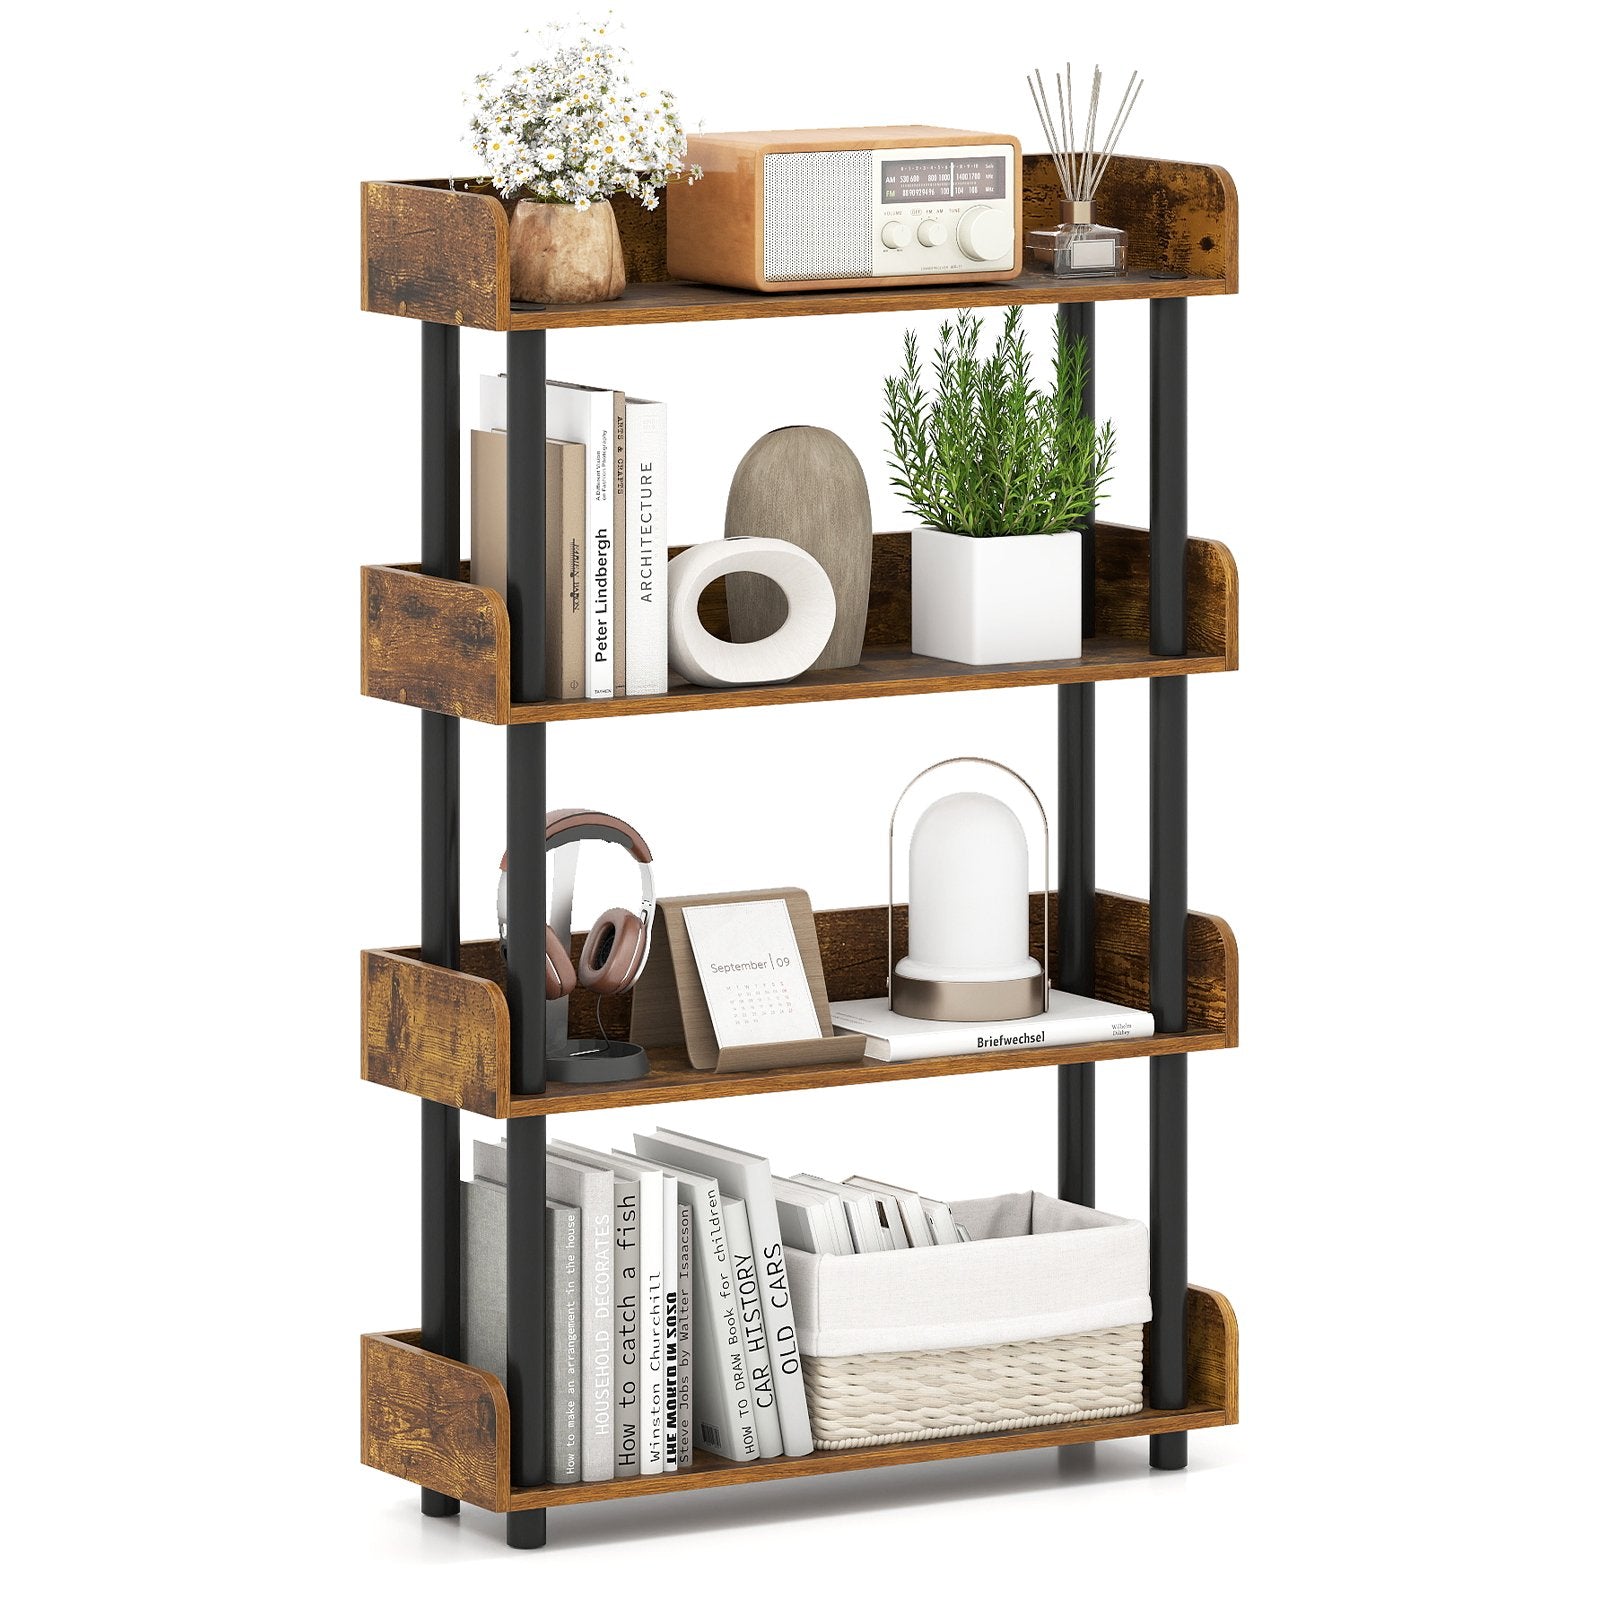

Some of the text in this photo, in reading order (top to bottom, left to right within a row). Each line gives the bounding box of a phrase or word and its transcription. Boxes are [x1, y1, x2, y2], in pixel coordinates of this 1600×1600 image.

[885, 176, 896, 184] AM
[594, 528, 611, 662] Peter Lindbergh
[640, 462, 653, 603] ARCHITECTURE
[710, 957, 790, 974] September 09
[977, 1031, 1045, 1048] Briefwechsel
[565, 1215, 577, 1474] How to make an arrangement in the house
[595, 1214, 609, 1435] HOUSEHOLD DECORATES
[616, 1195, 636, 1465] How to catch a fish
[649, 1272, 660, 1462] Winston Churchill
[679, 1209, 690, 1463] Steve Jobs by Walter Isaacson
[707, 1189, 755, 1454] HOW TO DRAW Book for children
[734, 1254, 774, 1408] CAR HISTORY
[763, 1243, 799, 1375] OLD CARS
